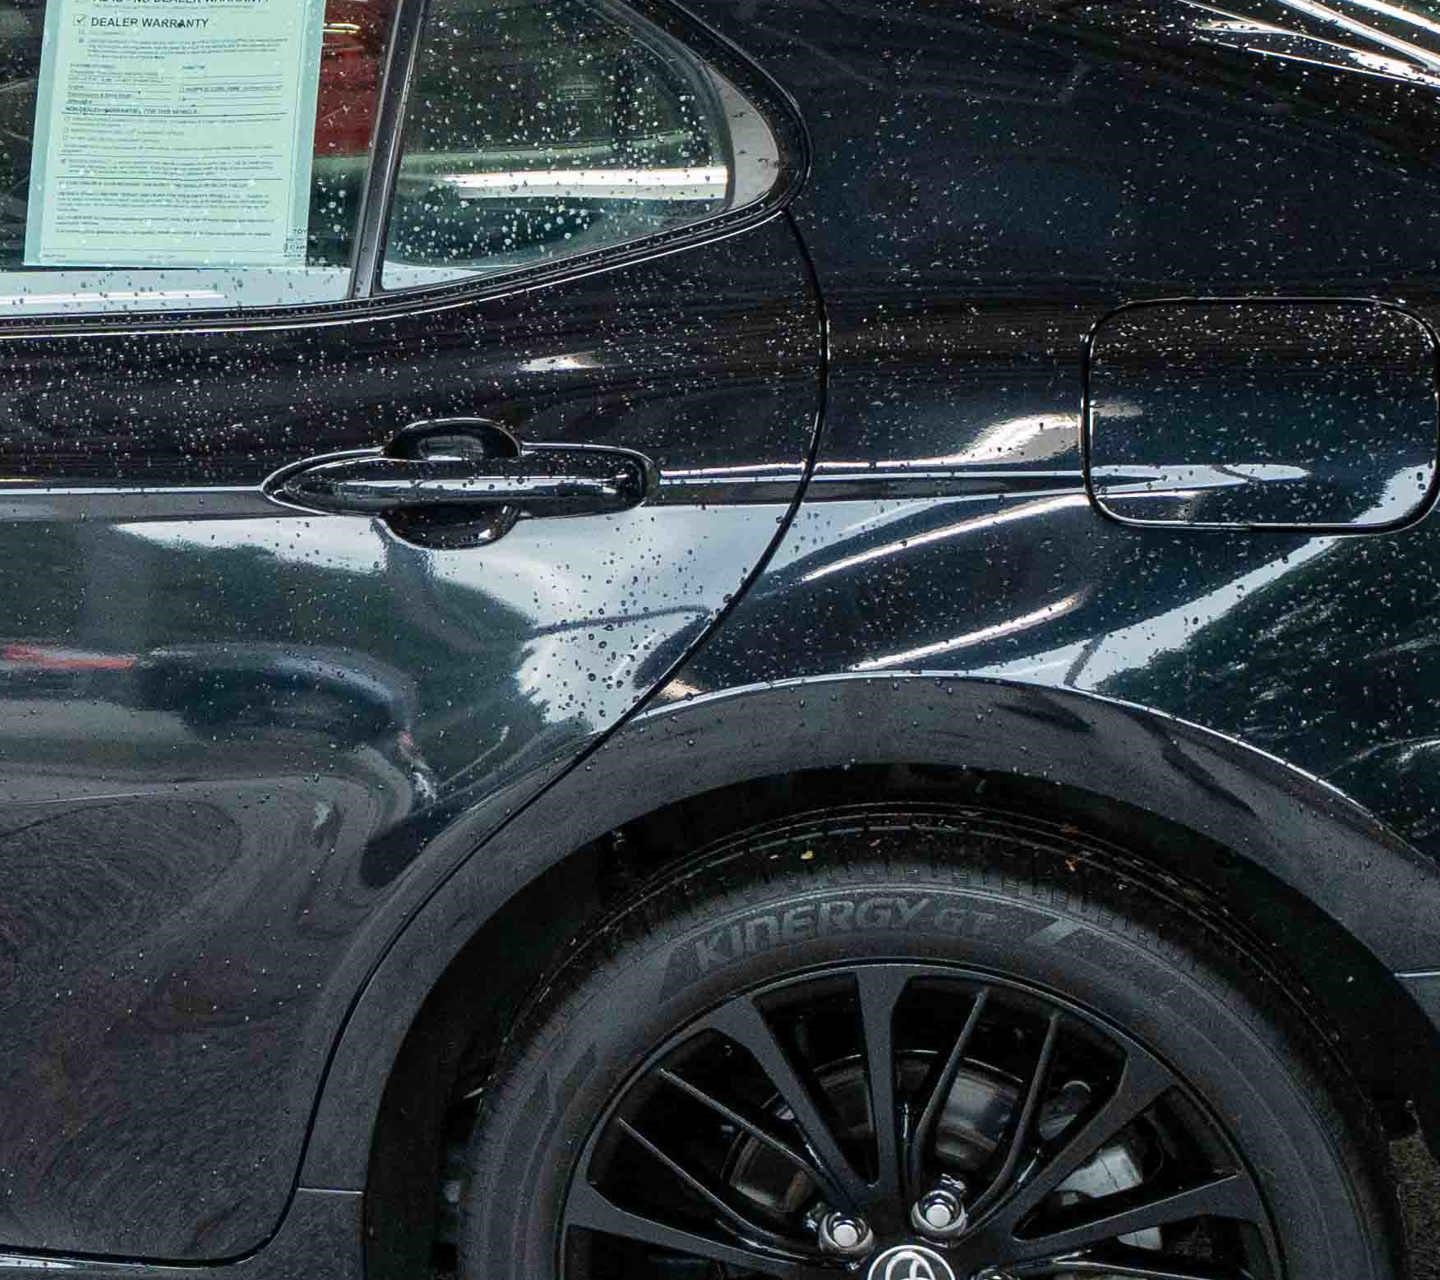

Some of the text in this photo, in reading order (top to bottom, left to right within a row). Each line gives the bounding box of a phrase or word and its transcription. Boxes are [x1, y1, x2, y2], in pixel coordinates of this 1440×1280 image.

[91, 17, 209, 29] DEALER WARRANTY
[695, 897, 931, 962] KINERGY
